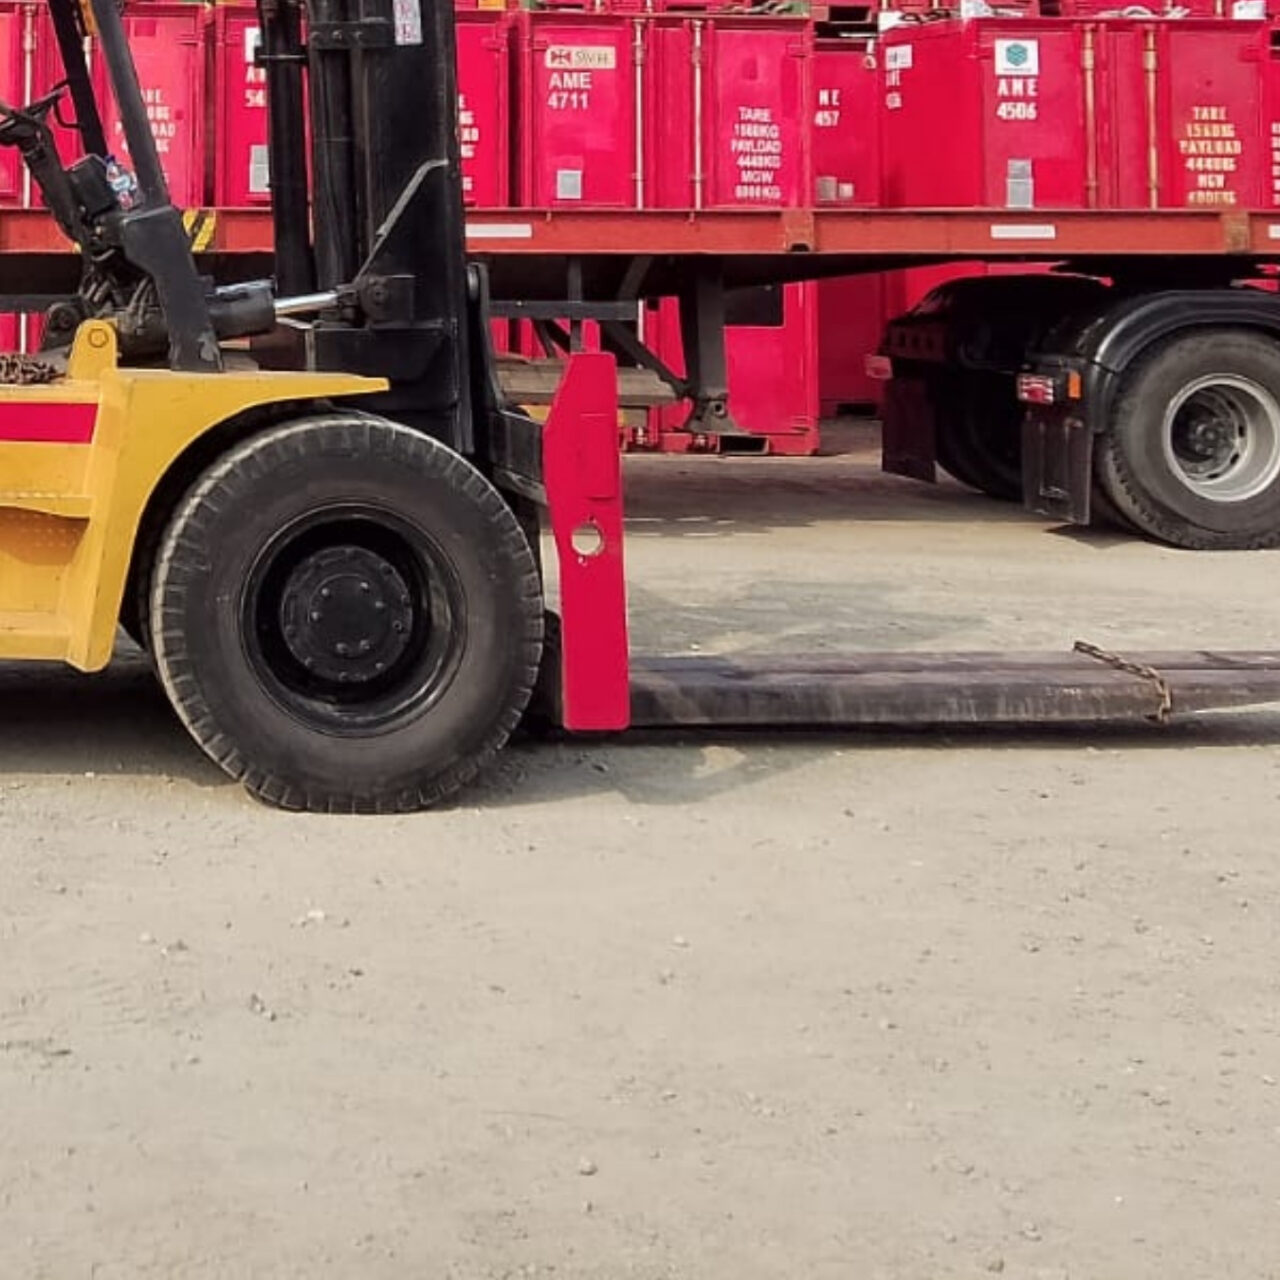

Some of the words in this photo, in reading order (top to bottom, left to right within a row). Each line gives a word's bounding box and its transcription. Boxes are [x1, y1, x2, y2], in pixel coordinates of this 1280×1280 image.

[548, 71, 593, 90] AME
[997, 77, 1039, 97] AME
[547, 91, 589, 110] 4711
[731, 138, 783, 154] PAYLOAD
[1179, 139, 1242, 155] PAYLOAD
[741, 170, 775, 184] MGW
